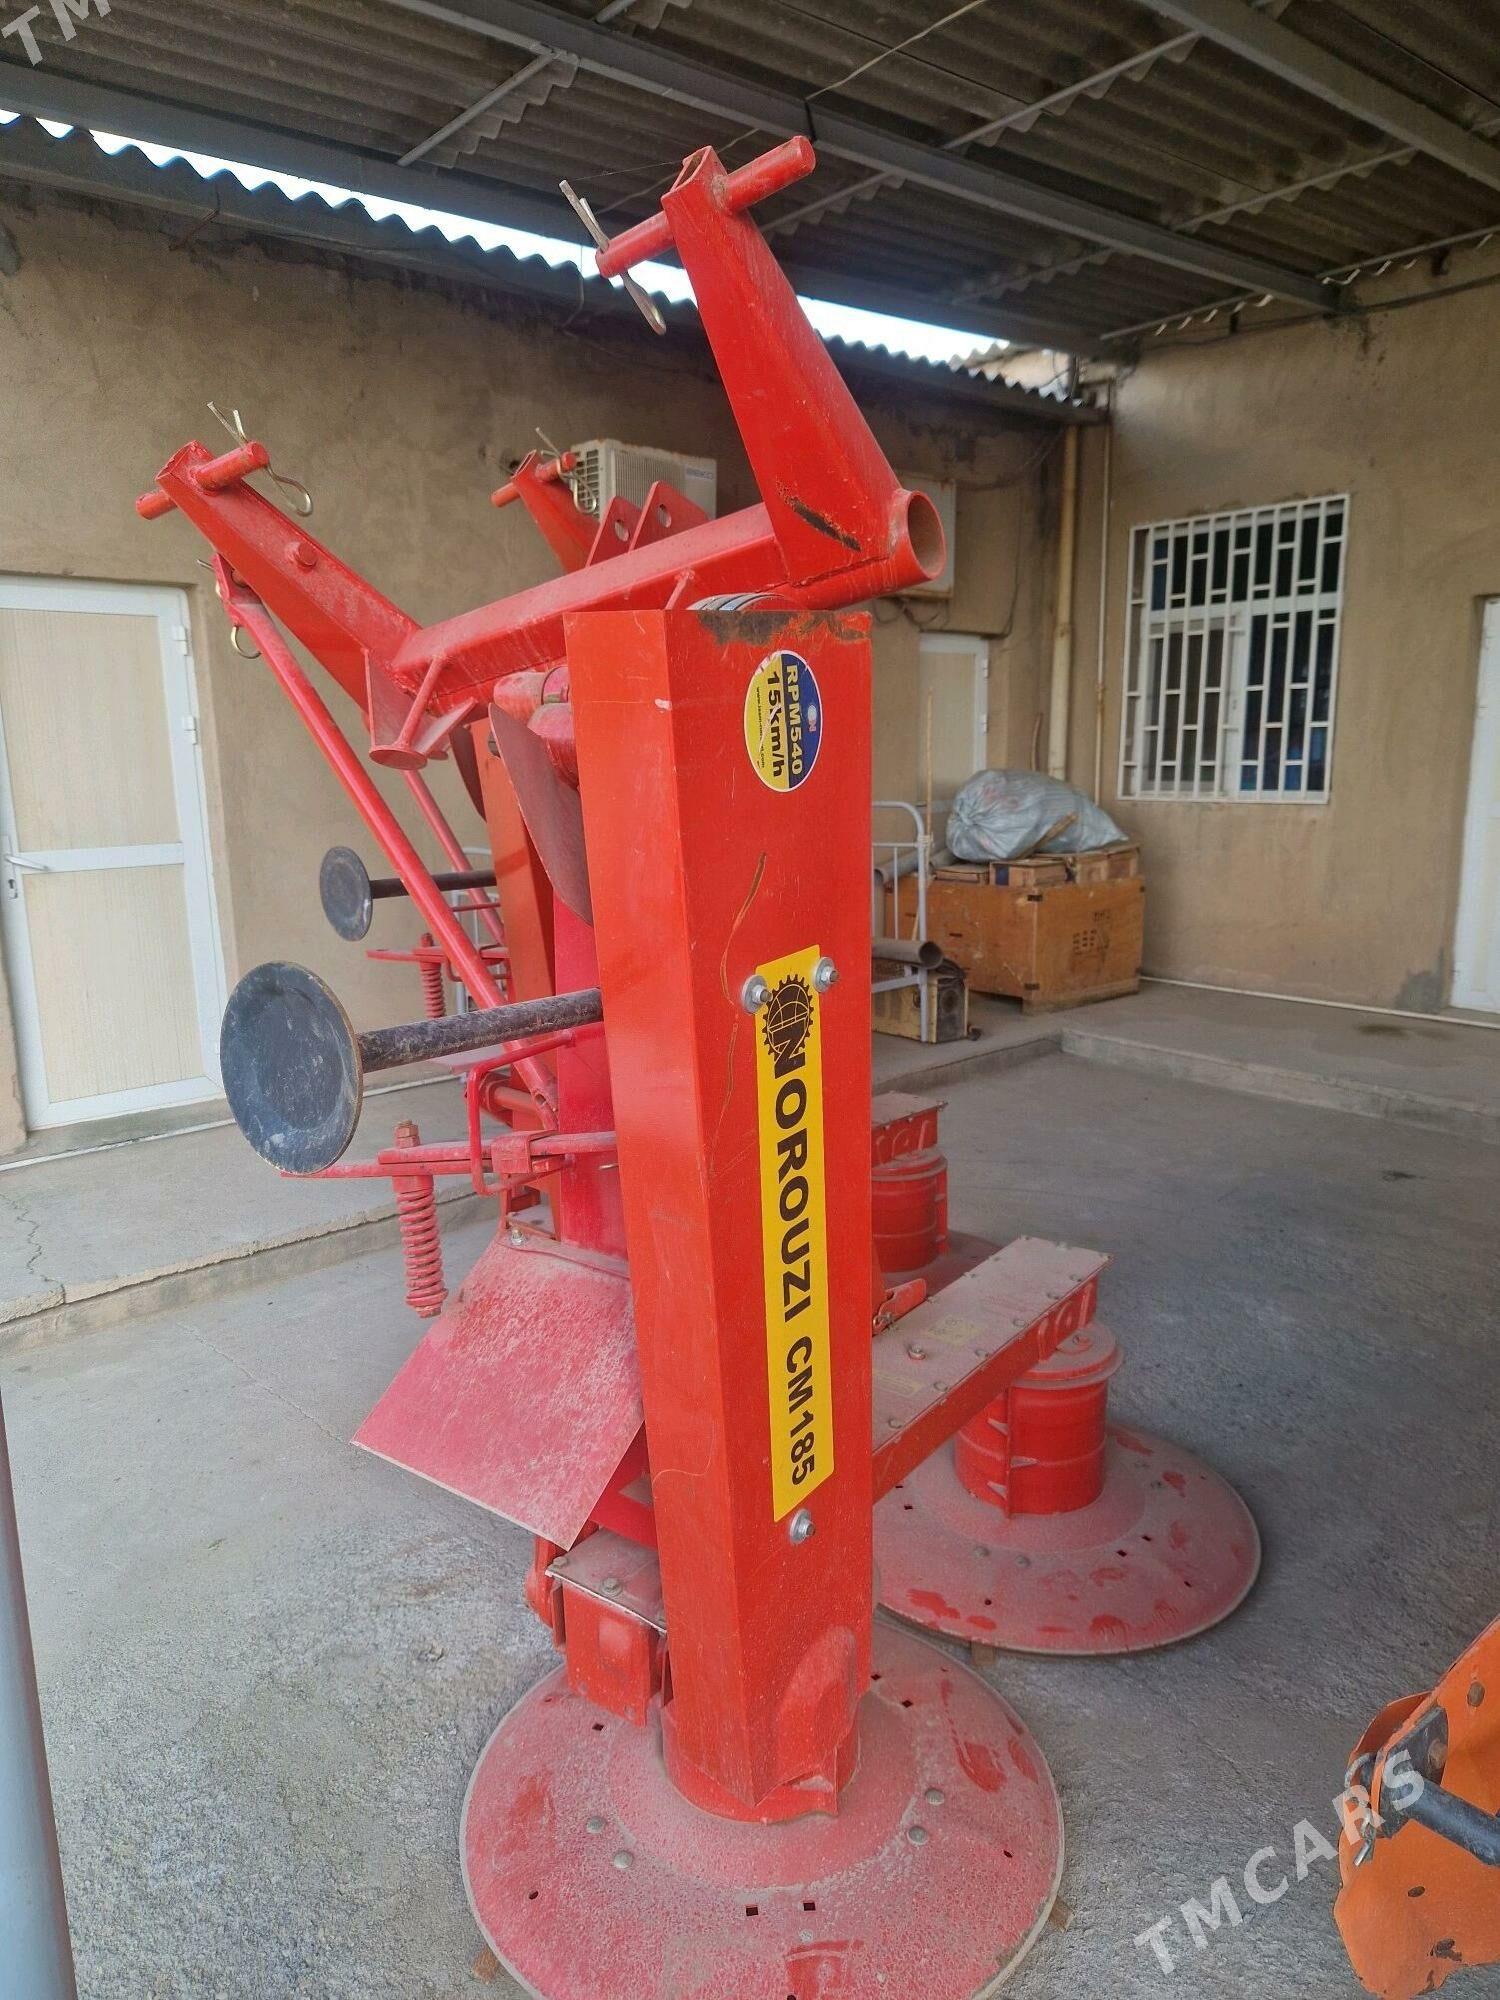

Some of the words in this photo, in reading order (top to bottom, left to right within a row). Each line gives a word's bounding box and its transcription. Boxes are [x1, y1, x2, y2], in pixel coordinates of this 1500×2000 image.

[767, 671, 785, 777] 15km/h
[786, 665, 802, 774] RPM540
[768, 1016, 811, 1322] NOROUZI
[786, 1335, 815, 1486] CM185
